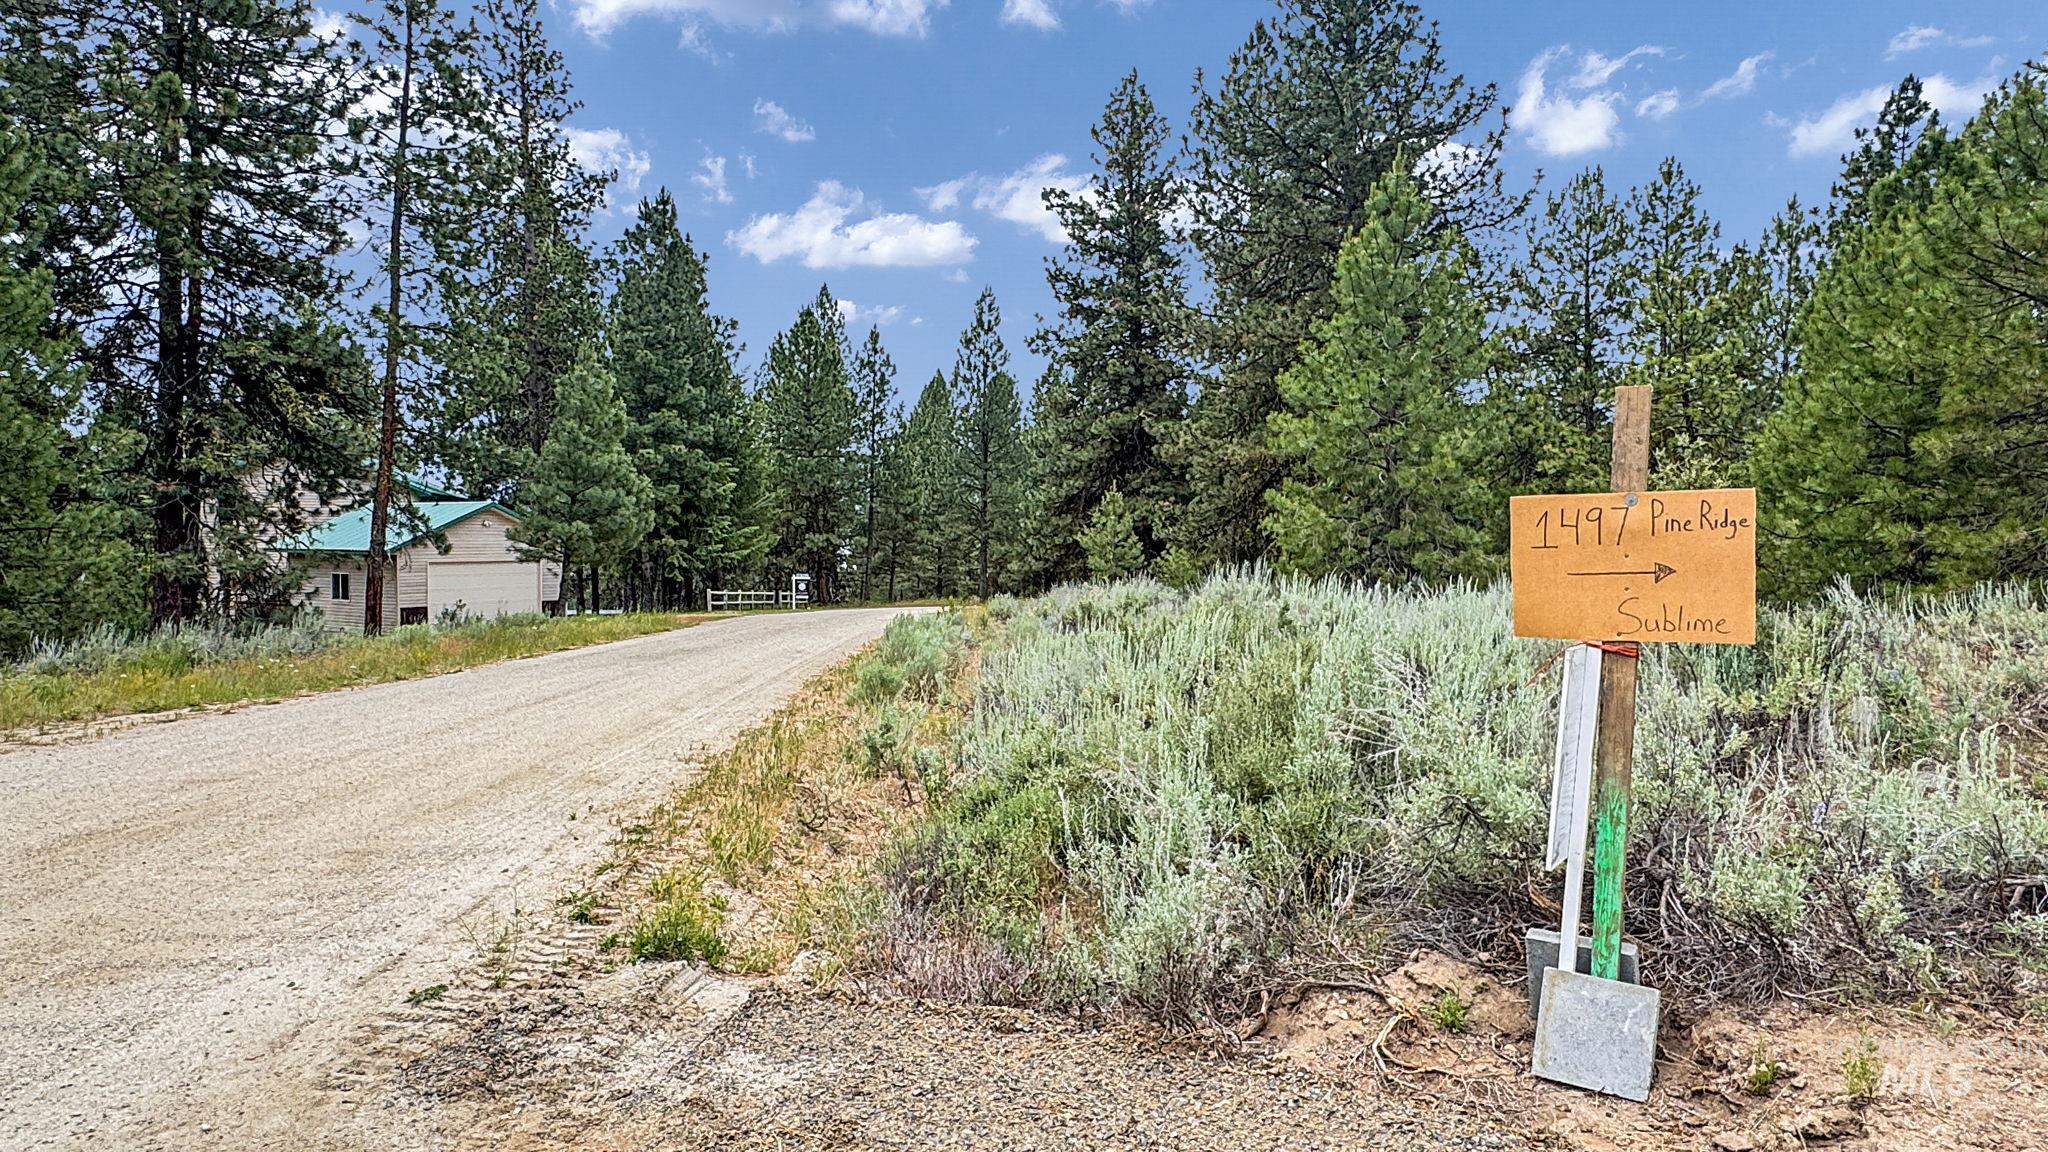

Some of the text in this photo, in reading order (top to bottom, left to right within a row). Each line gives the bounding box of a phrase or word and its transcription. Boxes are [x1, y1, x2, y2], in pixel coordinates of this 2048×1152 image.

[1531, 498, 1751, 549] 1497 Pine Ridge
[1616, 596, 1732, 637] Sublime
